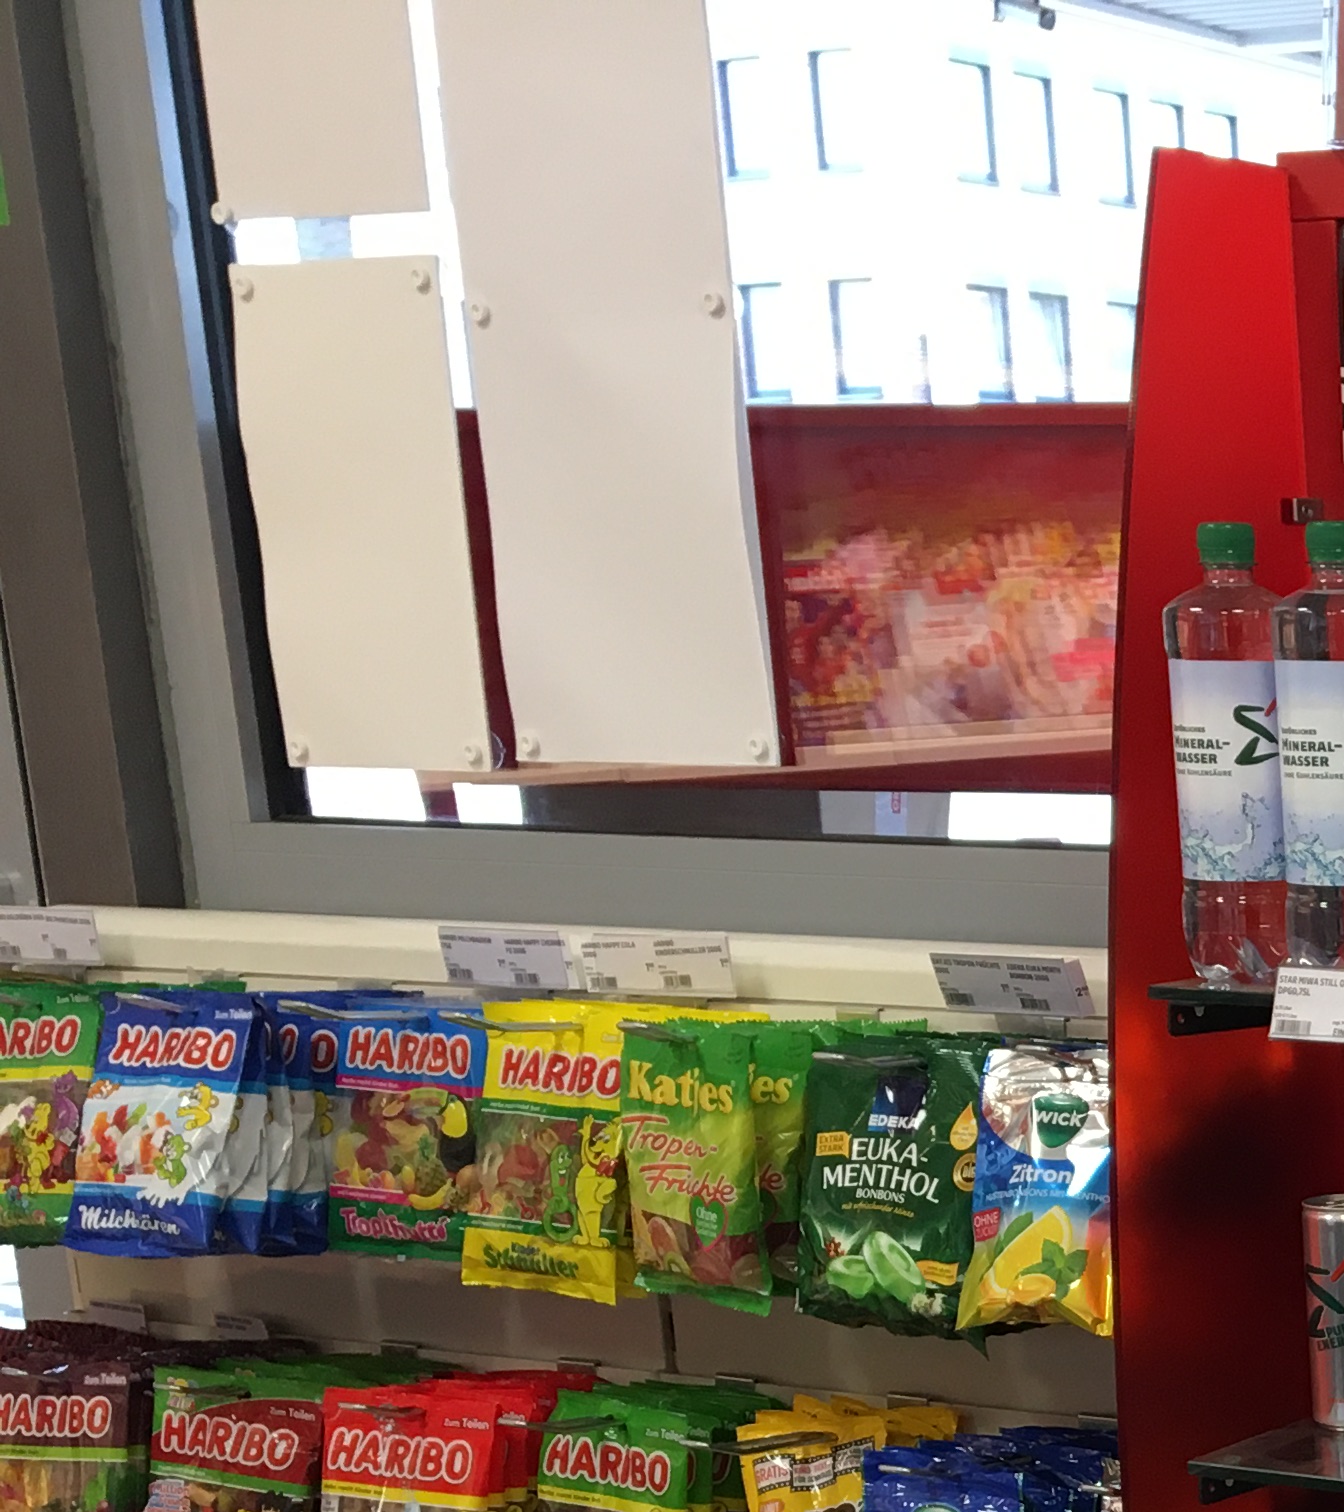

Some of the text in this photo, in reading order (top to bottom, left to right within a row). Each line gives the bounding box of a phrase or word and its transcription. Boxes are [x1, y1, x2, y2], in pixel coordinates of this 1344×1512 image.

[1279, 976, 1297, 985] STAR
[1320, 978, 1338, 987] STILL
[109, 1022, 236, 1071] HARIBO
[347, 1026, 472, 1079] HARIBO
[500, 1046, 621, 1098] HARIBO
[628, 1059, 733, 1116] Katjes
[622, 1114, 718, 1160] Tropen-
[818, 1133, 846, 1145] EXTRA
[868, 1113, 922, 1130] EDEKA
[1036, 1109, 1082, 1128] WICK
[819, 1143, 845, 1154] STARK
[851, 1137, 927, 1167] EUKA-
[823, 1166, 940, 1204] MENTHOL
[855, 1187, 906, 1204] BONBONS
[161, 1409, 299, 1470] HARIBO
[326, 1427, 472, 1484] HARIBO
[545, 1433, 671, 1495] HARIBO
